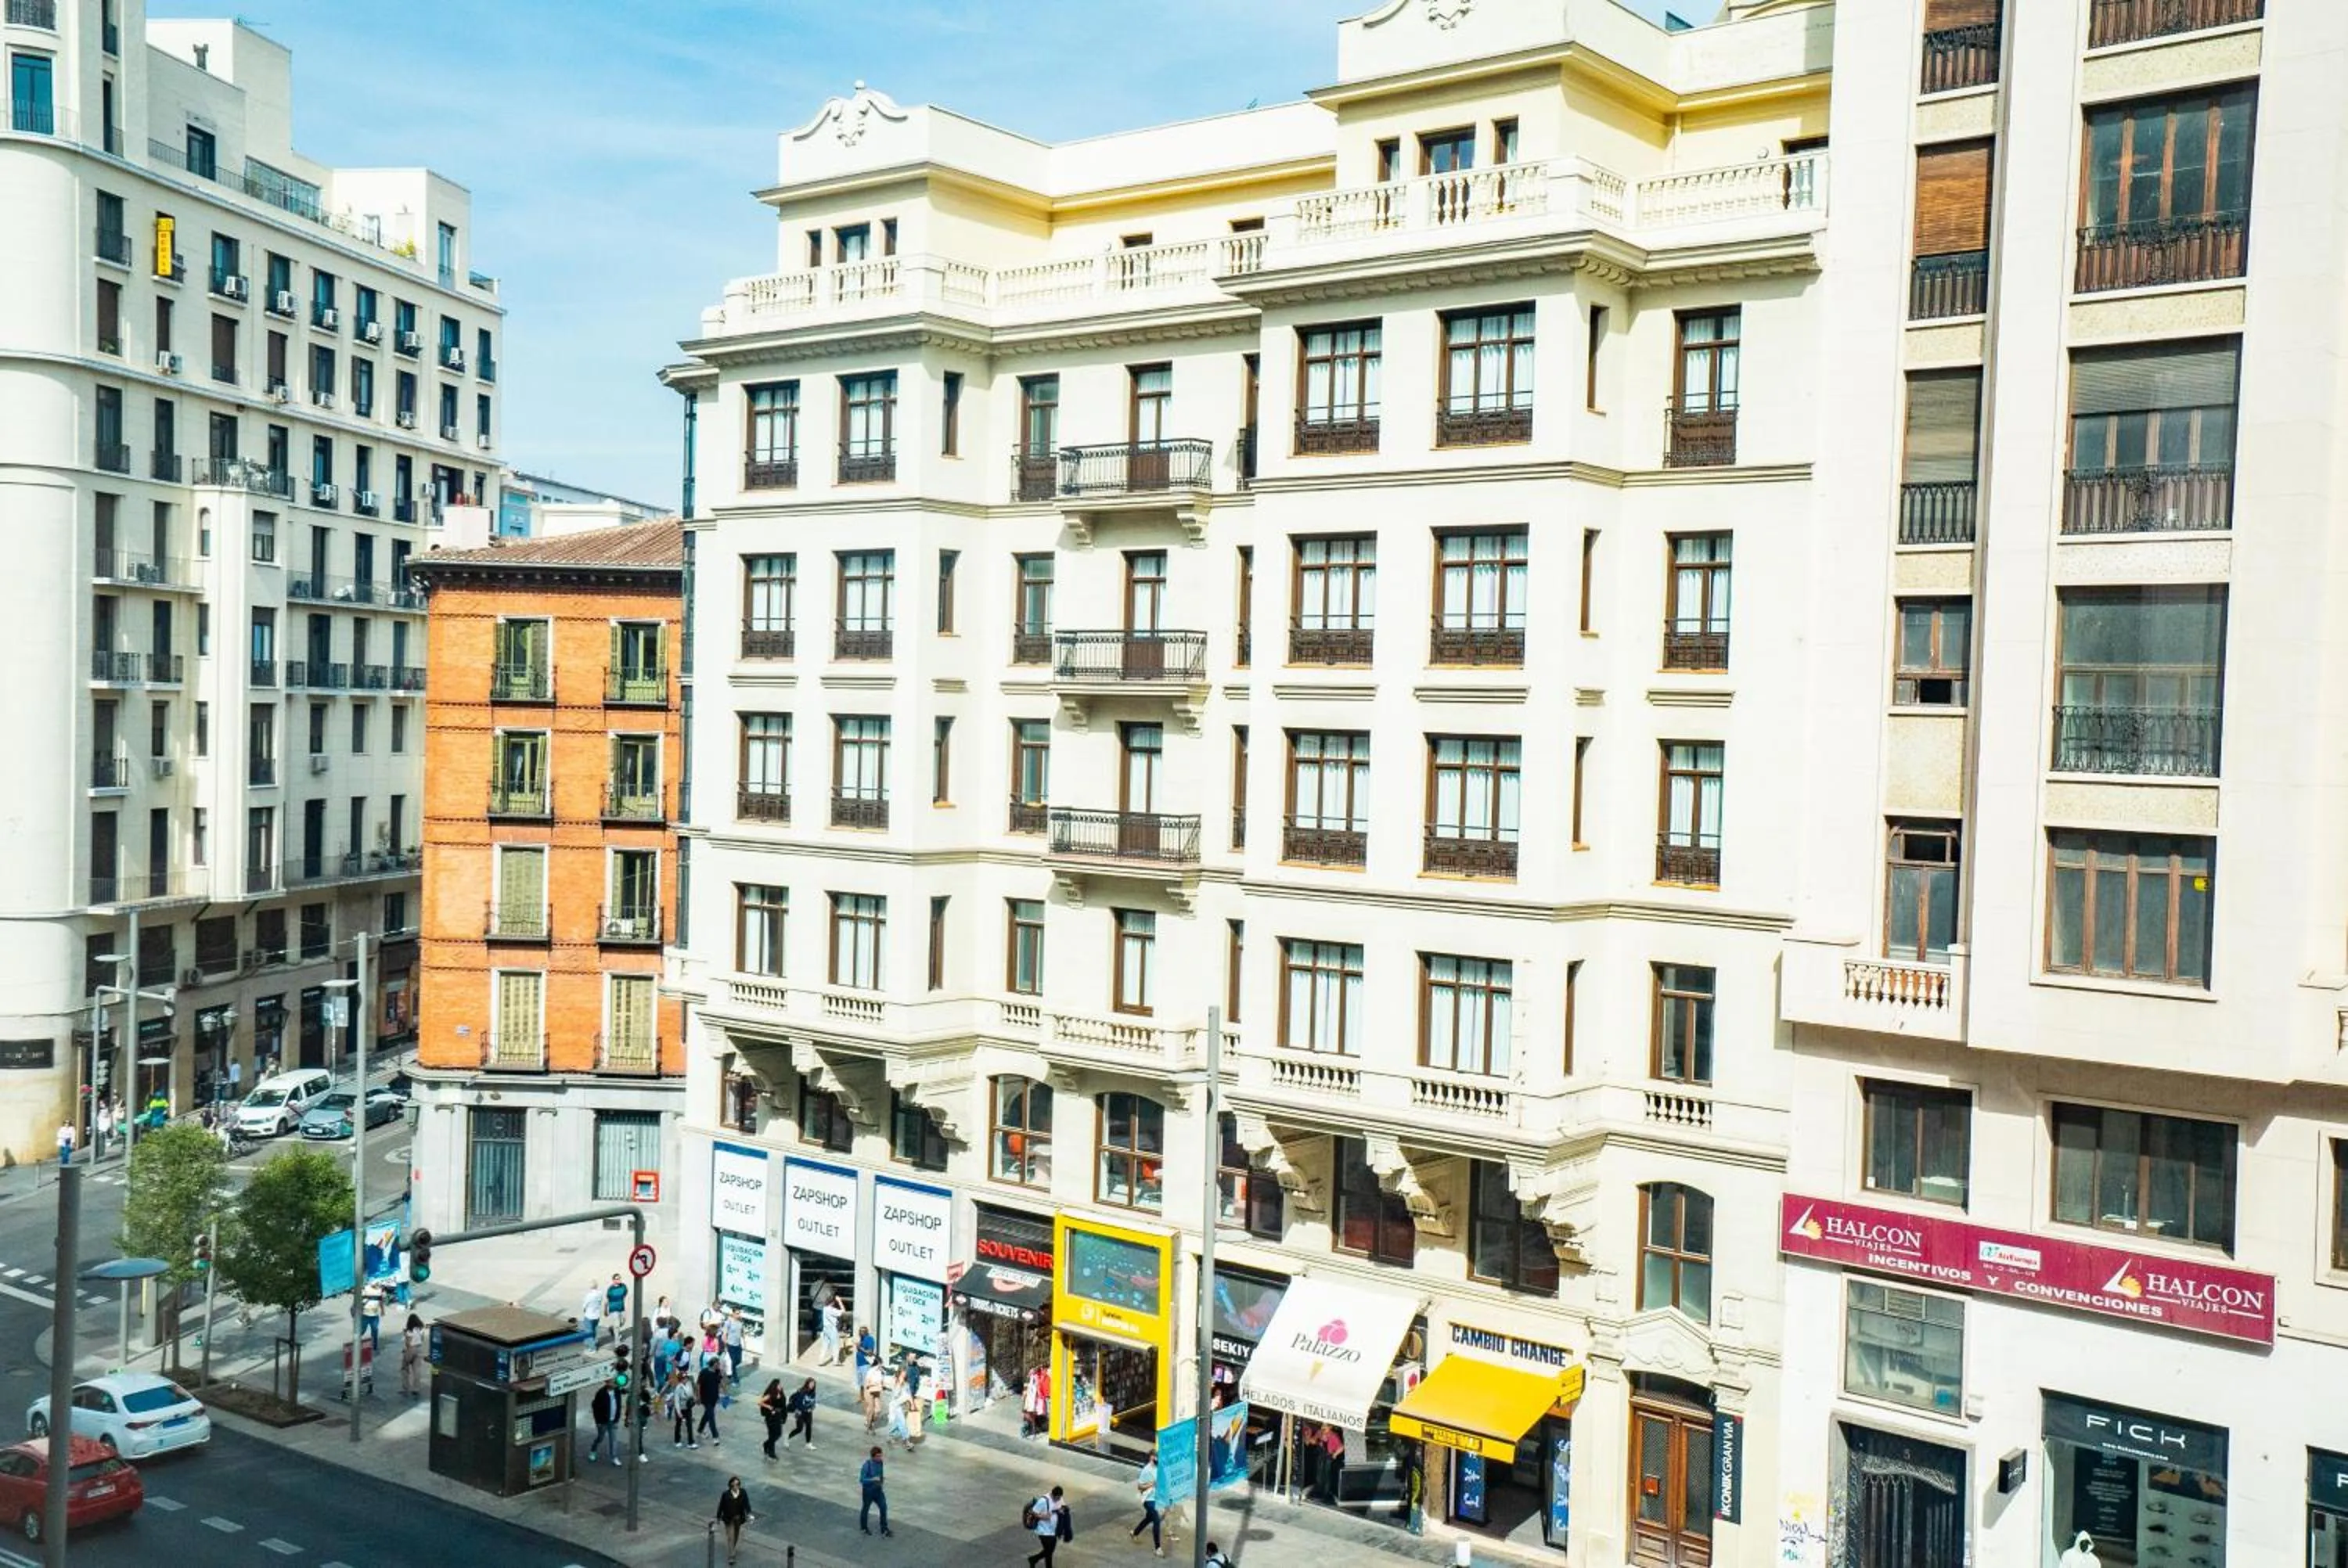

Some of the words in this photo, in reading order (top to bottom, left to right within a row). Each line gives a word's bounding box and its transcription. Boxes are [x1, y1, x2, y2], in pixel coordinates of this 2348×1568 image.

[719, 1171, 762, 1190] ZAPSHOP
[722, 1199, 757, 1214] OUTLET
[792, 1185, 848, 1209] ZAPSHOP
[798, 1217, 840, 1238] OUTLET
[884, 1206, 942, 1230] ZAPSHOP
[1825, 1216, 1923, 1250] HALCON
[888, 1239, 934, 1261] OUTLET
[1853, 1239, 1892, 1253] VIAJES
[1868, 1253, 1972, 1281] INCENTIVOS
[1986, 1275, 2000, 1286] Y
[2013, 1280, 2163, 1318] CONVENCIONES
[2145, 1273, 2265, 1311] HALCON
[2180, 1297, 2229, 1314] VIAJES
[1290, 1332, 1362, 1364] Palazzo
[1451, 1325, 1505, 1353] CAMBIO
[1510, 1339, 1566, 1368] CHANGE
[1242, 1387, 1296, 1411] HELADOS
[1302, 1403, 1365, 1429] ITALIANOS
[2086, 1414, 2186, 1449] FICK
[1723, 1440, 1733, 1473] GRAN
[1720, 1472, 1732, 1516] IKONIK
